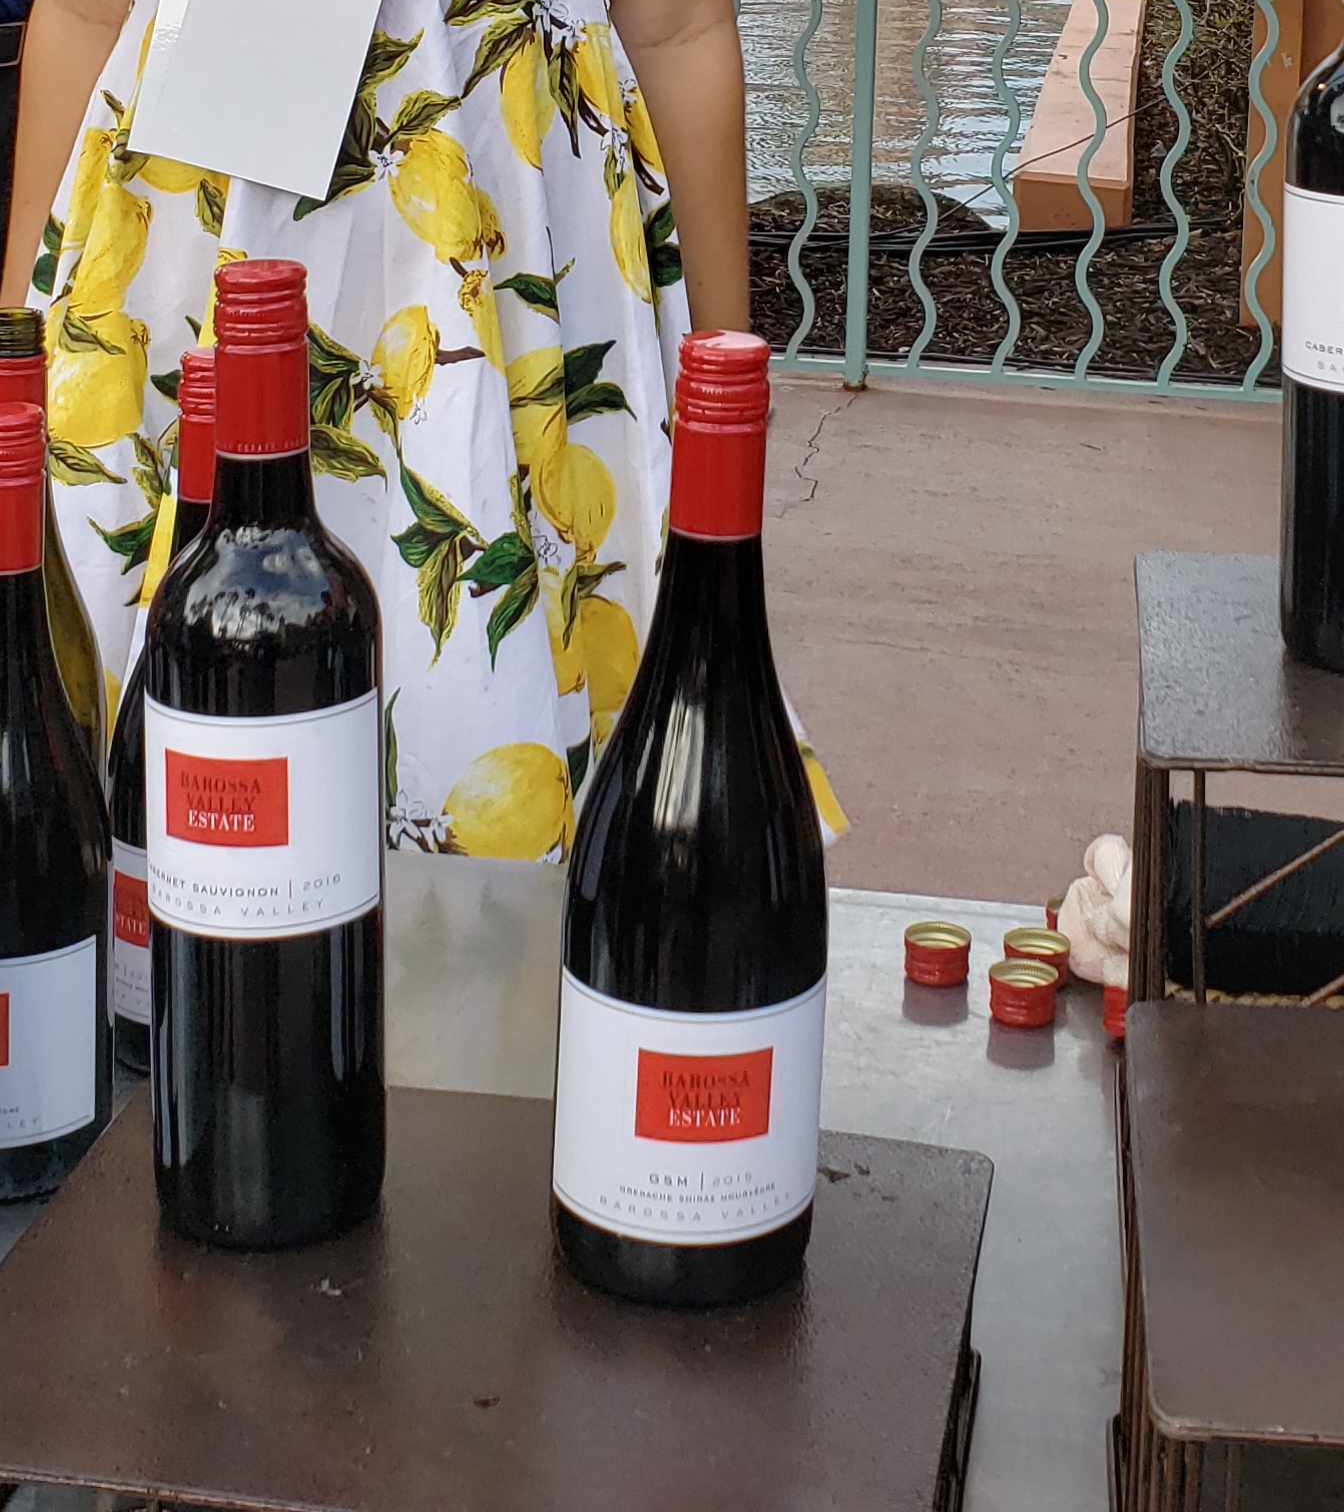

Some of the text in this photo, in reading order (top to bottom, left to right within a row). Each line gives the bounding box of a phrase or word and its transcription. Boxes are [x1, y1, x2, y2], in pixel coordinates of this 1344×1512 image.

[181, 771, 261, 794] BAROSSA
[187, 793, 256, 812] VALLEY
[189, 809, 255, 832] ESTATE
[152, 883, 222, 915] BAROSSA
[240, 899, 324, 917] VALLEY
[192, 883, 279, 897] SAUVIGNON
[663, 1071, 749, 1089] BAROSSA
[669, 1090, 741, 1109] VALLEY
[669, 1107, 741, 1128] ESTATE
[649, 1173, 688, 1188] GSM
[600, 1192, 790, 1222] BAROSSA VALLEY
